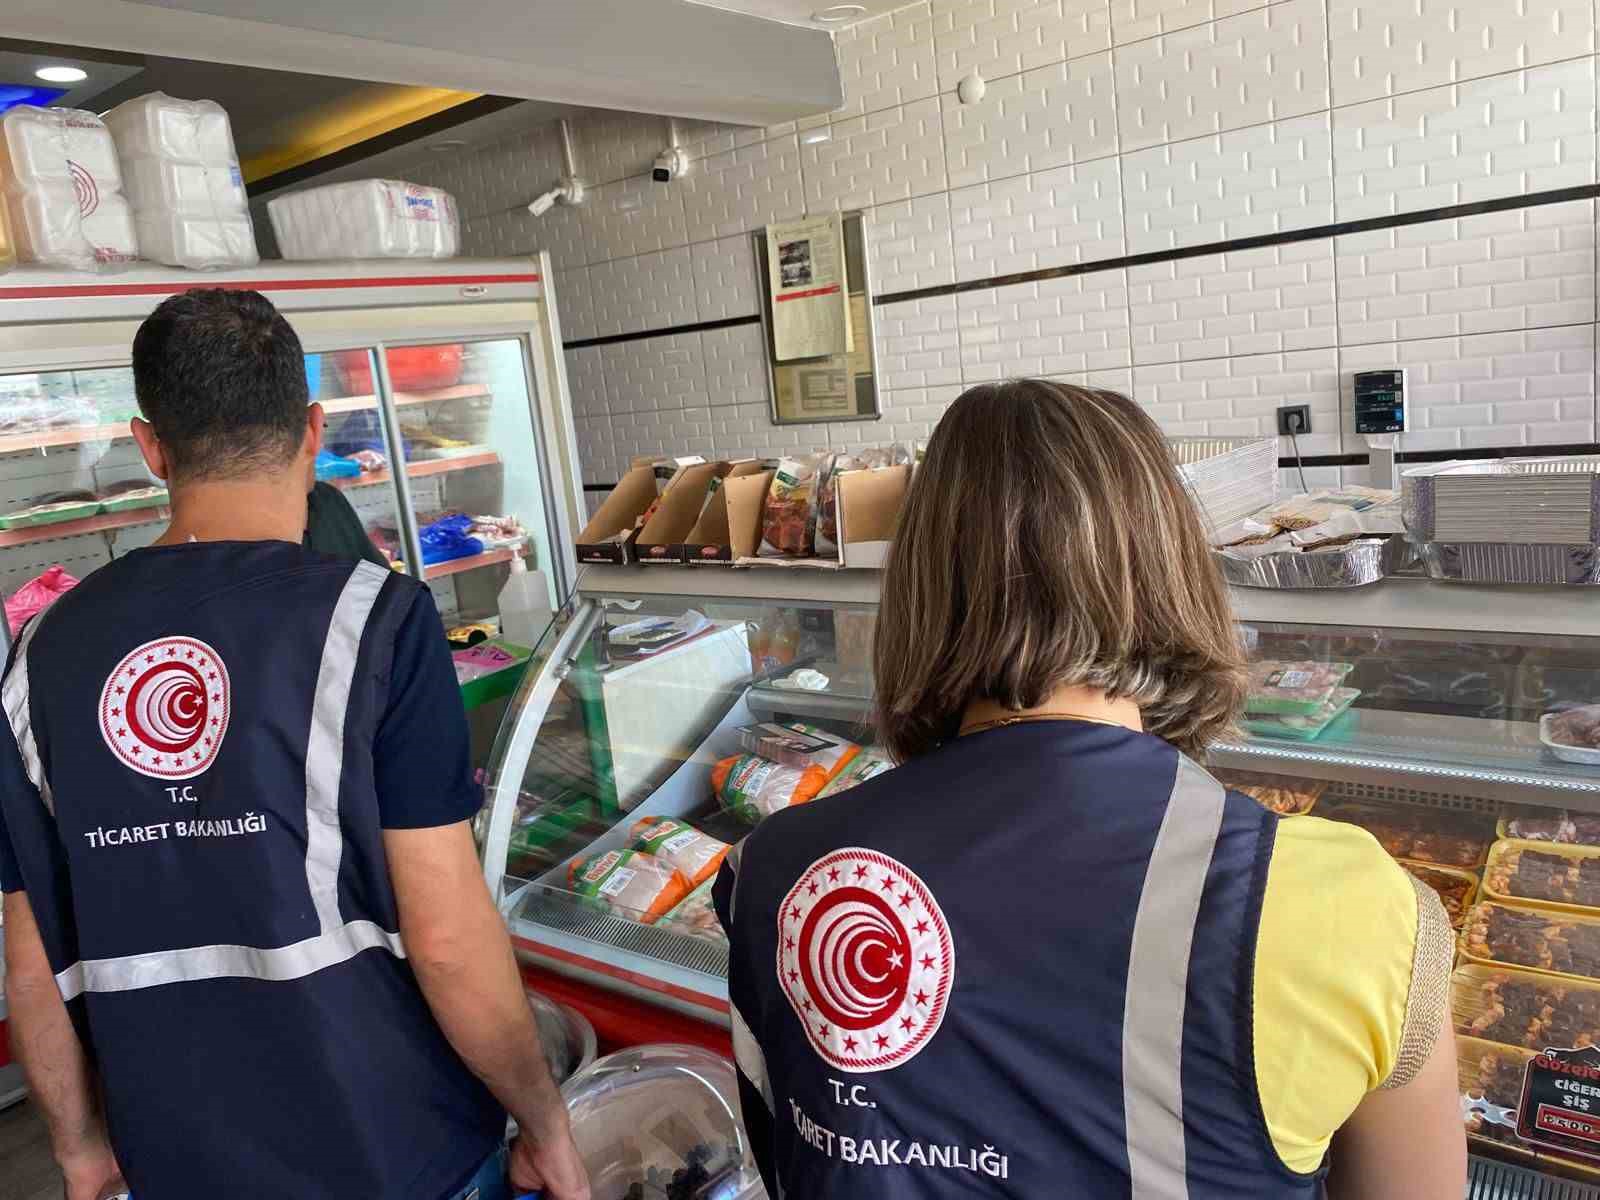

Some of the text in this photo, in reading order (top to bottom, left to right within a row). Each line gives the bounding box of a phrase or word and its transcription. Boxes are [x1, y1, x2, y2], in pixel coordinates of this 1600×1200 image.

[165, 786, 198, 803] T.C.
[84, 812, 267, 848] TİCARET BAKANLIĞI
[828, 1078, 877, 1109] T.C.
[788, 1097, 1008, 1179] İCARET BAKANLIĞI
